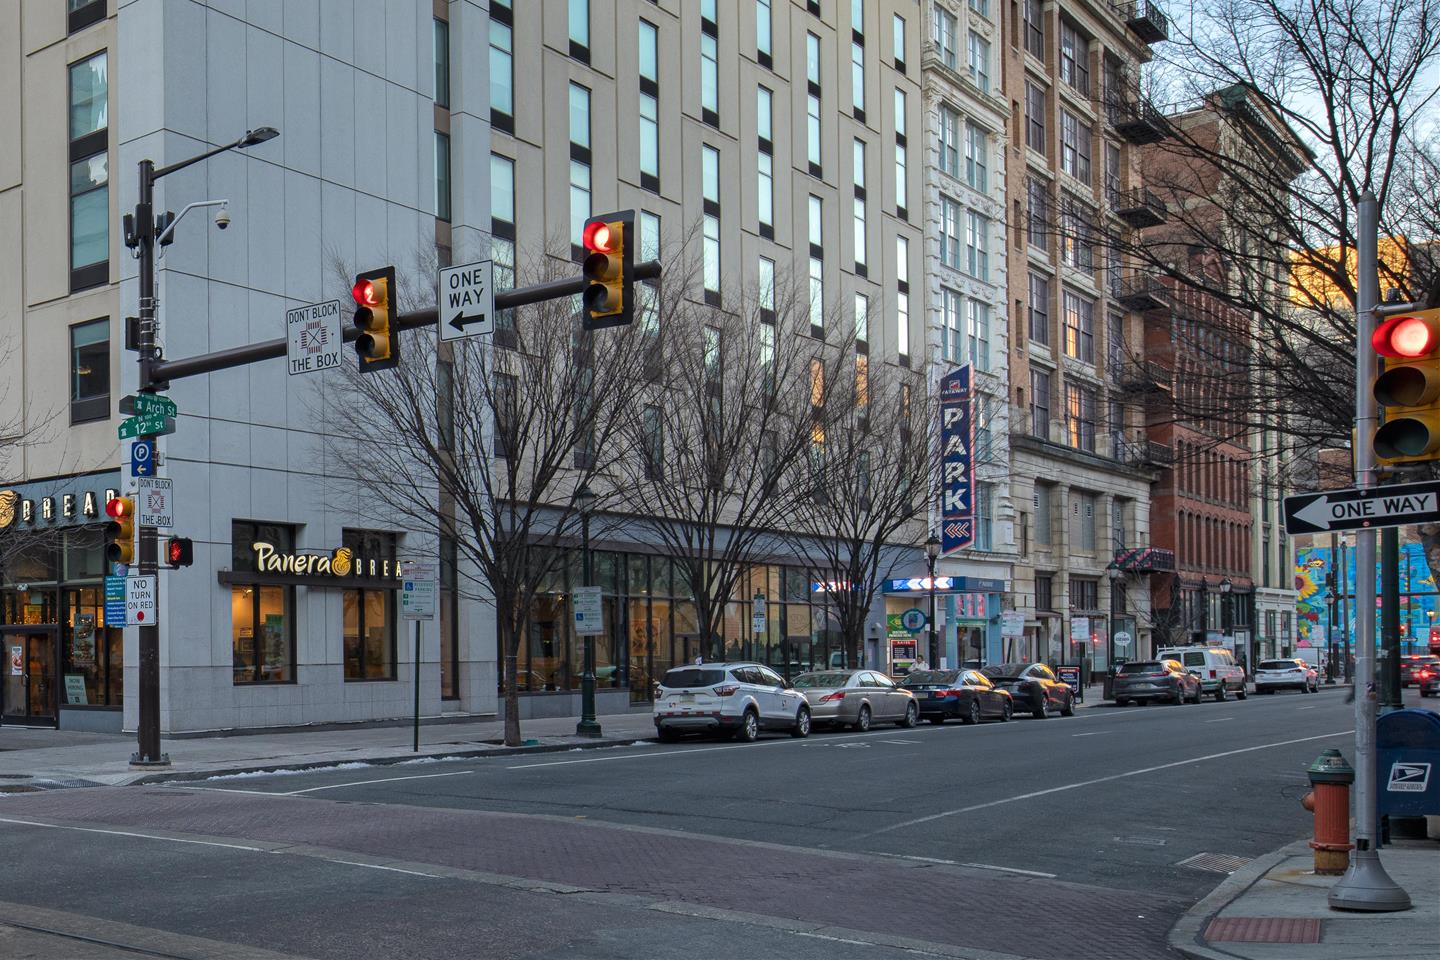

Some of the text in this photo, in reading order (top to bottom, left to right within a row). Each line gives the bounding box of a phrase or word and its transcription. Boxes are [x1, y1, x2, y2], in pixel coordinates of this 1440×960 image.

[449, 268, 483, 290] ONE
[449, 287, 484, 309] WAY
[312, 303, 338, 319] BLOCK
[292, 352, 339, 373] THE BOX
[146, 401, 176, 417] Arch St
[155, 420, 164, 430] St
[943, 407, 969, 512] PARK
[155, 480, 172, 490] BLOCK
[1332, 495, 1430, 519] ONE WAY
[142, 515, 171, 526] THE BOX
[253, 541, 331, 575] Panera
[356, 558, 412, 578] BREA
[133, 579, 148, 590] NO
[130, 591, 151, 600] TURN
[128, 601, 154, 610] ON RED
